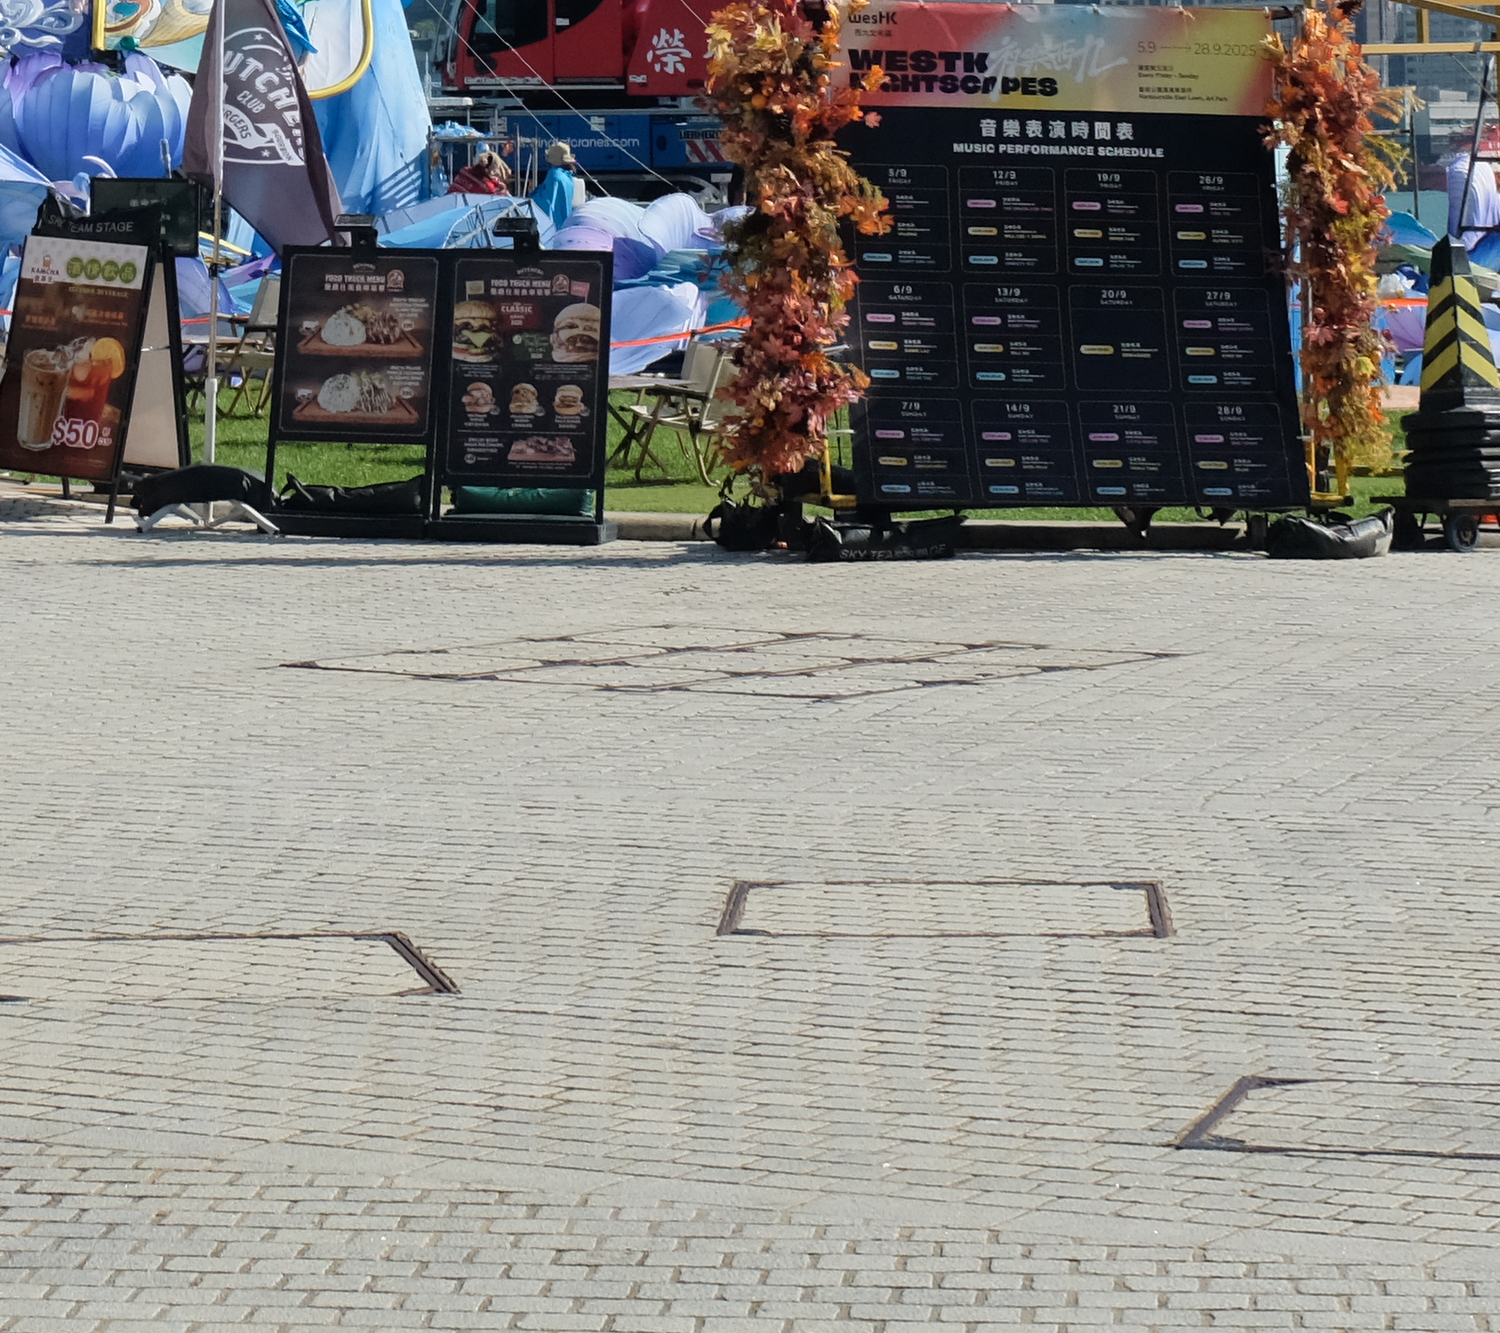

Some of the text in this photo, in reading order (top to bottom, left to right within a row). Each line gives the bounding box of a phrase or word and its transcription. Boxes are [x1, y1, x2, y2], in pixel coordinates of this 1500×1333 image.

[646, 27, 692, 75] 榮
[848, 48, 990, 74] WESTK
[1137, 41, 1257, 57] 5.9 28.9.2025
[849, 71, 1059, 97] NGHTSCAPES
[236, 90, 266, 114] CLUB
[979, 118, 1135, 141] 音樂表演時間表
[953, 142, 1165, 159] MUSIC PERFORMANCE SCHEDULE
[95, 221, 134, 233] STAGE
[52, 416, 99, 449] $50
